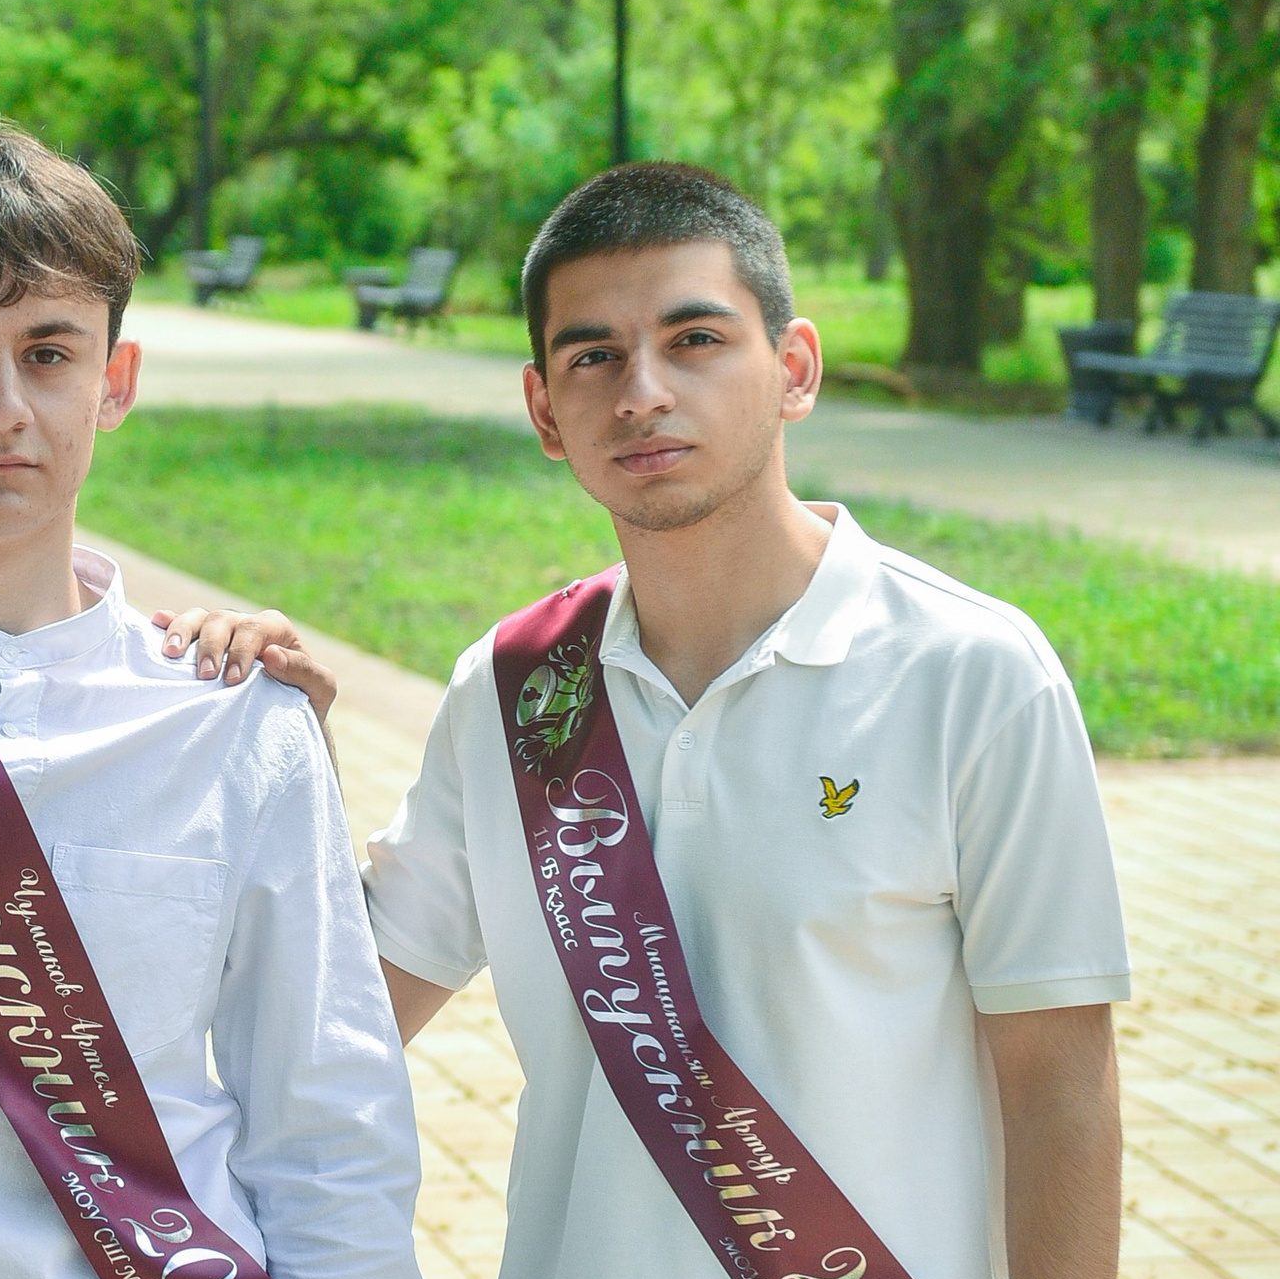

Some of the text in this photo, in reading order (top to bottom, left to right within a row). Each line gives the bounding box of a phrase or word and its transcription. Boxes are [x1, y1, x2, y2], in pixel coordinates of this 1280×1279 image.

[546, 883, 578, 951] класс
[4, 867, 119, 1108] Чумаков Артем
[546, 769, 796, 1251] Выпускник
[711, 1095, 798, 1185] Артур
[61, 1172, 108, 1223] МОУ
[93, 1227, 131, 1265] СШ
